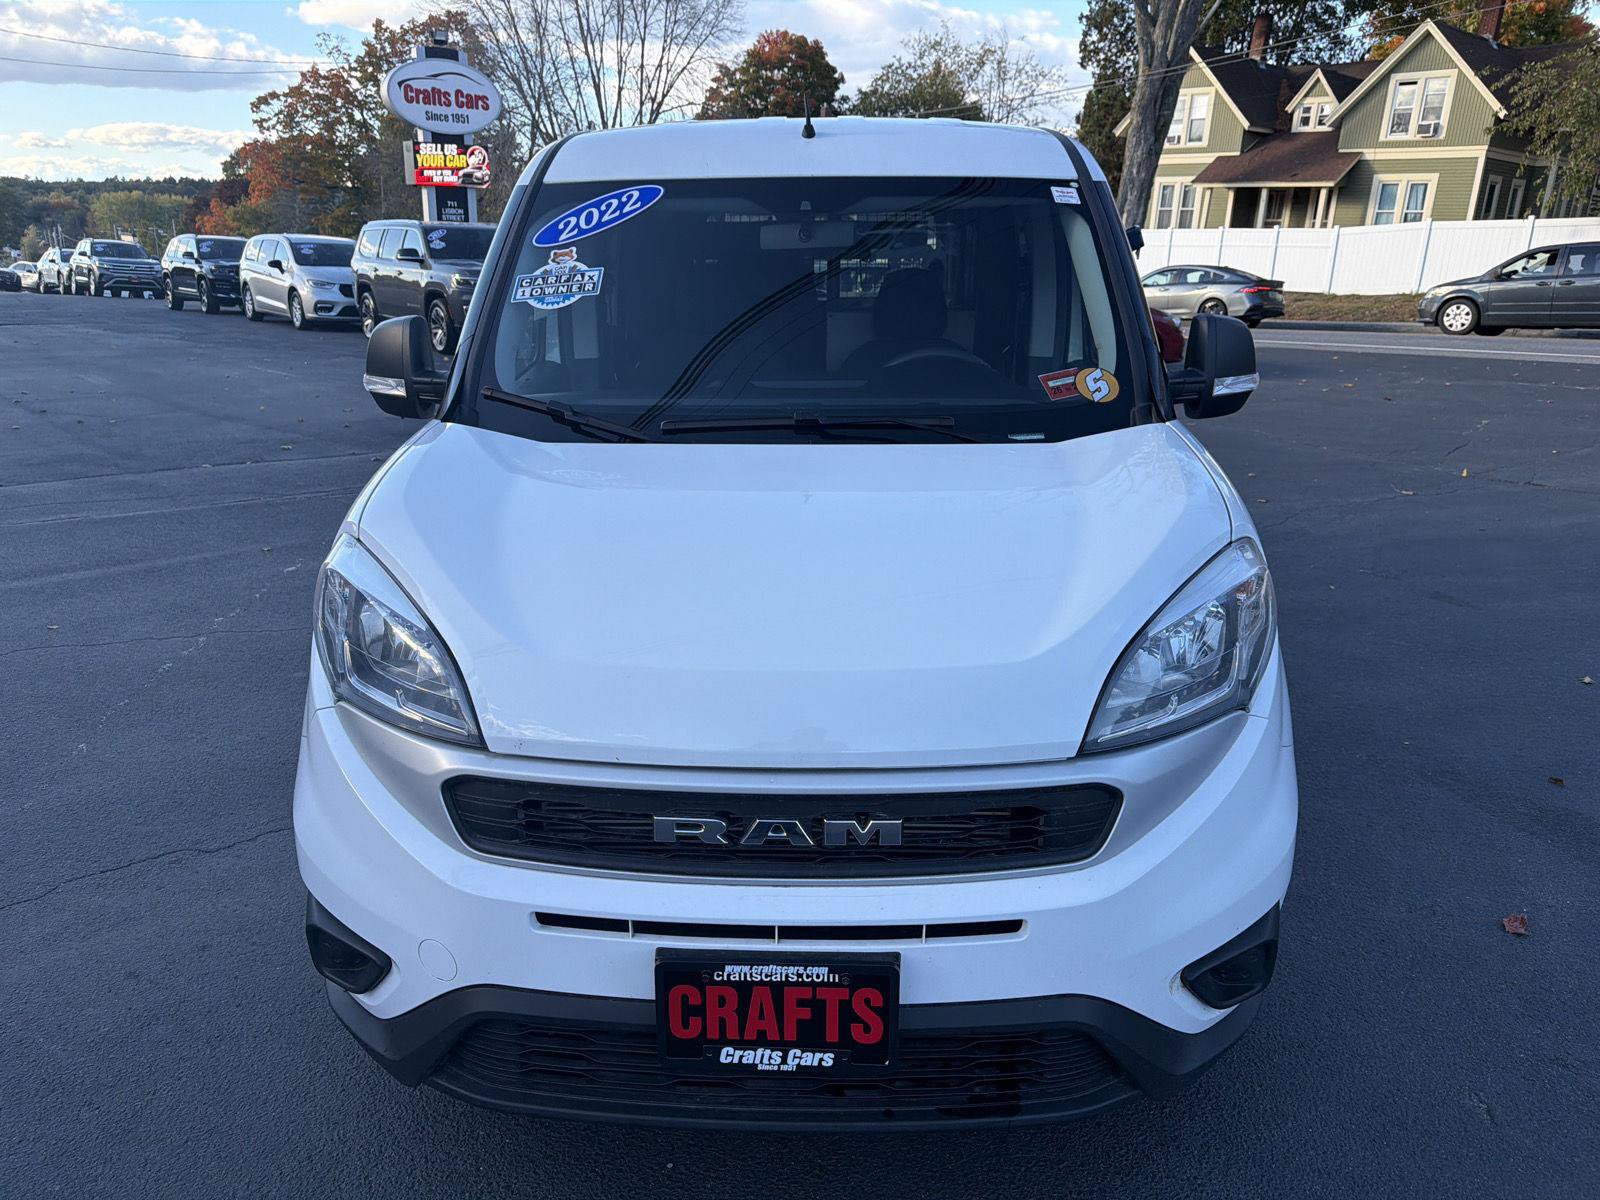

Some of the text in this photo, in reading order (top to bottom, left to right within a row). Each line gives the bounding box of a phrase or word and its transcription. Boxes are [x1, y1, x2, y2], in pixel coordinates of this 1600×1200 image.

[403, 83, 490, 111] Crafts Cars
[425, 111, 470, 124] Since 1951
[419, 143, 457, 155] SELL US
[416, 154, 467, 168] YOUR CAR
[558, 190, 642, 242] 2022
[522, 274, 596, 288] CARFAX
[520, 283, 594, 297] 1 OWNER
[653, 816, 903, 846] RAM
[724, 964, 829, 974] www.craftscars.com
[713, 970, 839, 983] craftscars.com
[668, 984, 884, 1045] CRAFTS
[719, 1046, 835, 1067] Crafts Cars
[757, 1063, 797, 1072] Since 1951
